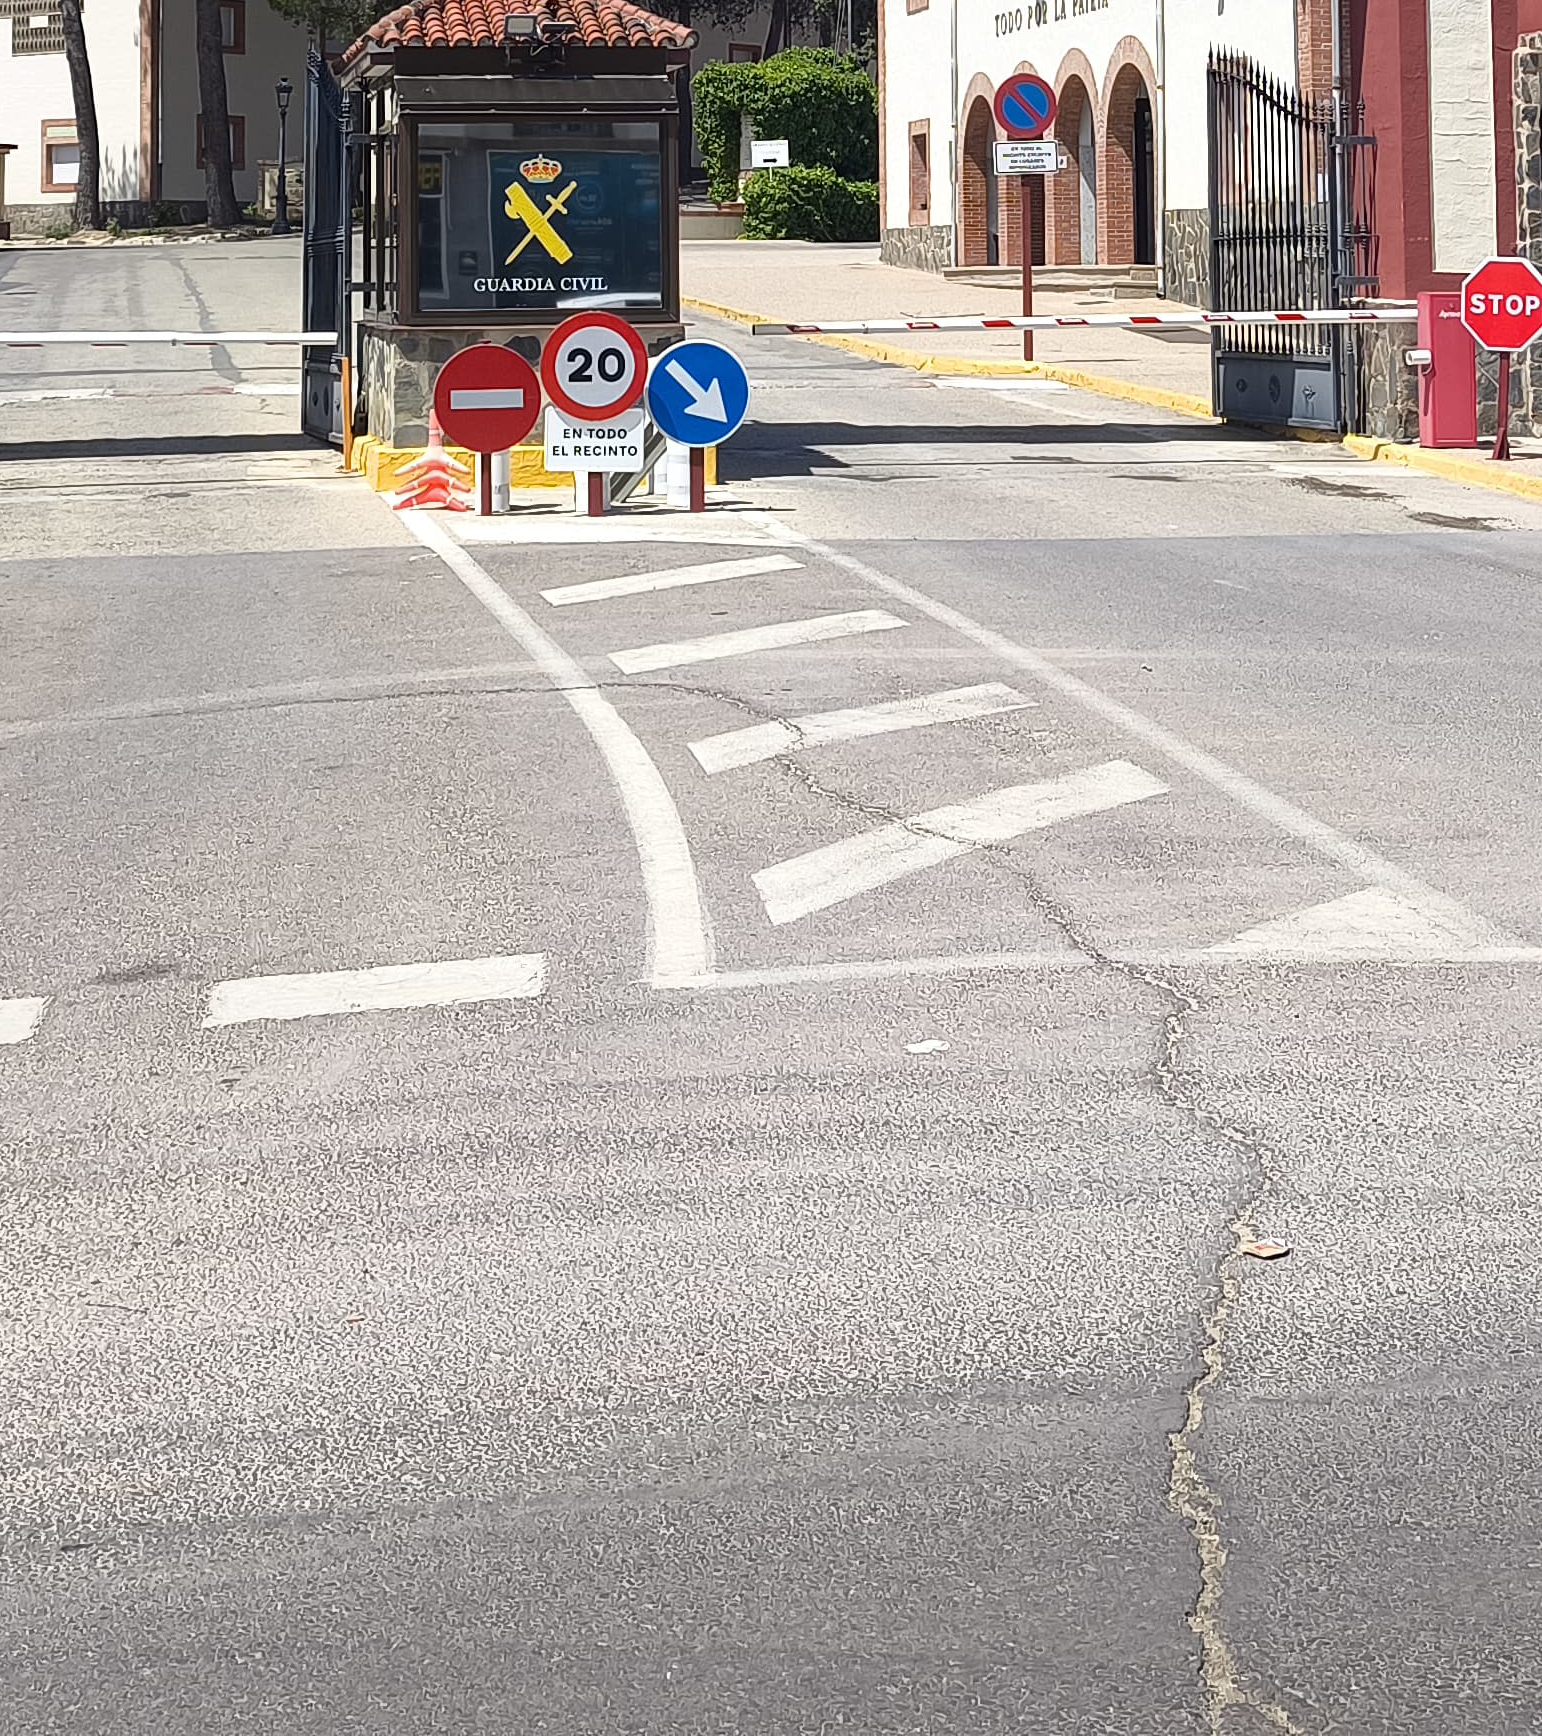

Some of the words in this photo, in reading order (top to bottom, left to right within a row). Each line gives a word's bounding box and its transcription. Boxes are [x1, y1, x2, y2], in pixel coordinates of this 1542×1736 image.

[995, 9, 1023, 37] TODO
[1027, 1, 1047, 29] POR
[474, 278, 555, 292] GUARDIA
[560, 277, 607, 291] CIVIL
[1470, 293, 1540, 316] STOP
[567, 347, 625, 383] 20
[563, 428, 583, 440] EN
[589, 428, 627, 439] TODO
[552, 445, 570, 457] EL
[575, 445, 638, 457] RECINTO
